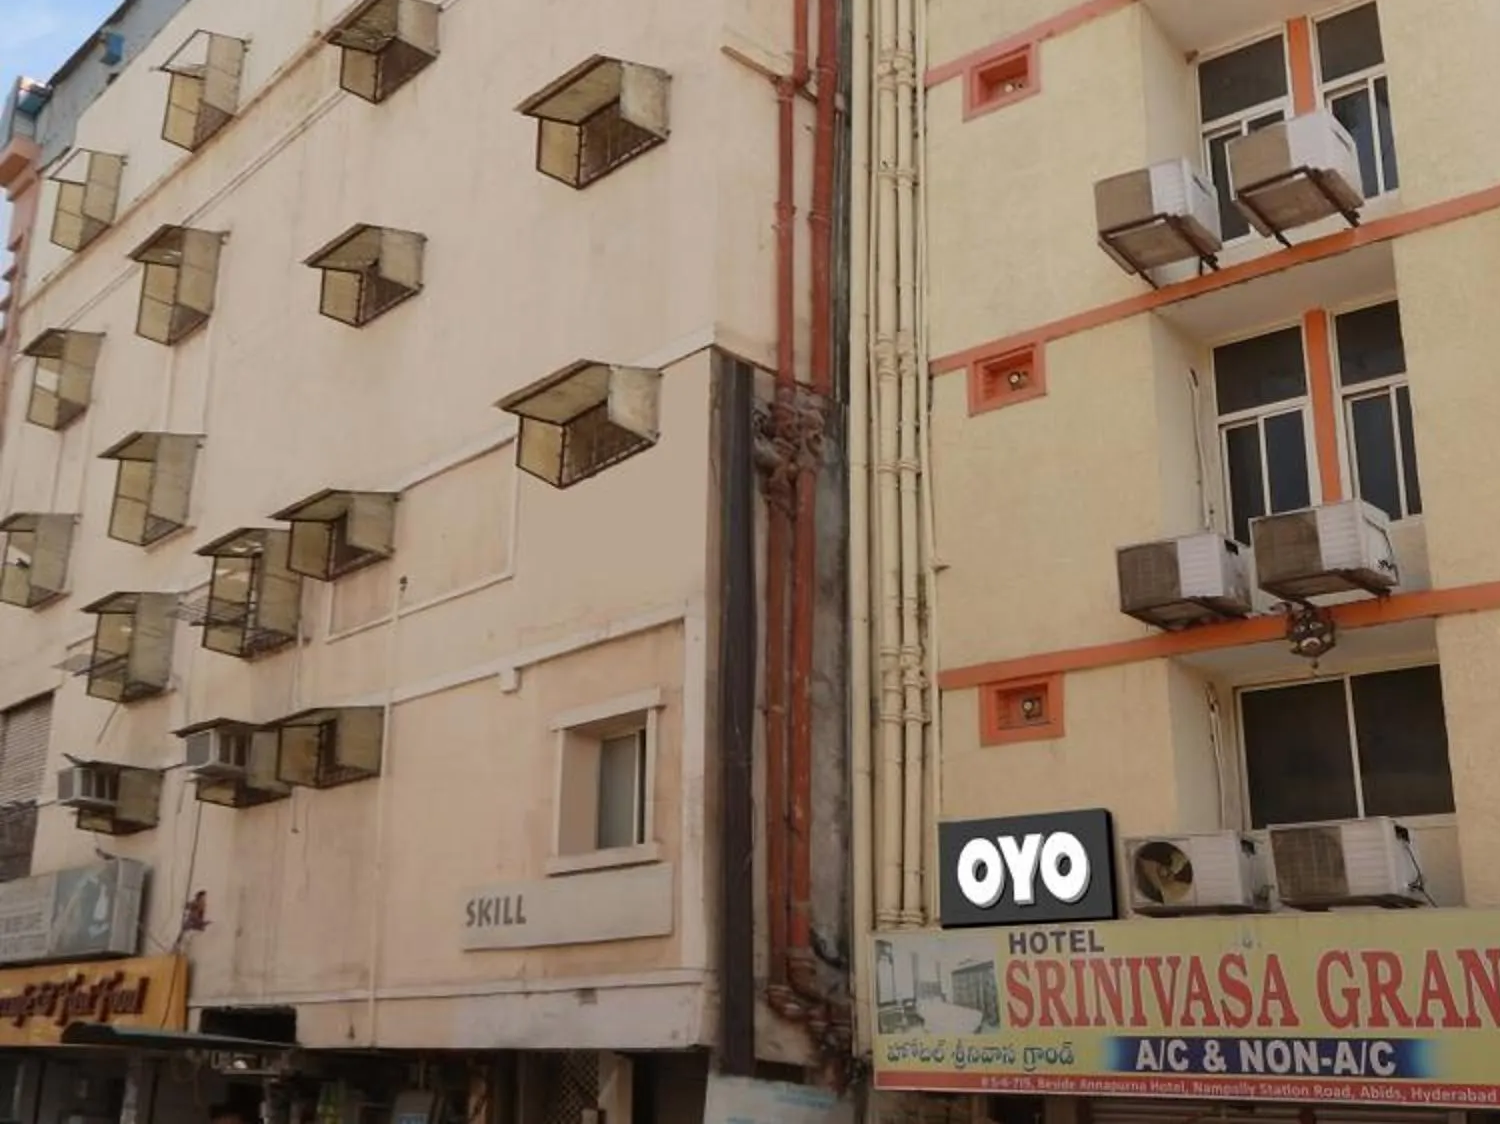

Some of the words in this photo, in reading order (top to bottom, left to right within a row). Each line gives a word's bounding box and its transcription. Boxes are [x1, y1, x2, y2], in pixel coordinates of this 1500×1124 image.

[957, 831, 1090, 908] OYO
[465, 894, 527, 927] SKILL
[1008, 928, 1105, 955] HOTEL
[1006, 951, 1300, 1029] SRINIVASA
[1134, 1038, 1189, 1072] A/C
[1202, 1040, 1227, 1072] &
[1239, 1038, 1397, 1077] NON-A/C
[1260, 1083, 1309, 1097] Station
[1314, 1084, 1355, 1099] Road,
[1360, 1085, 1407, 1101] Abids,
[1411, 1087, 1498, 1103] Hyderabad
